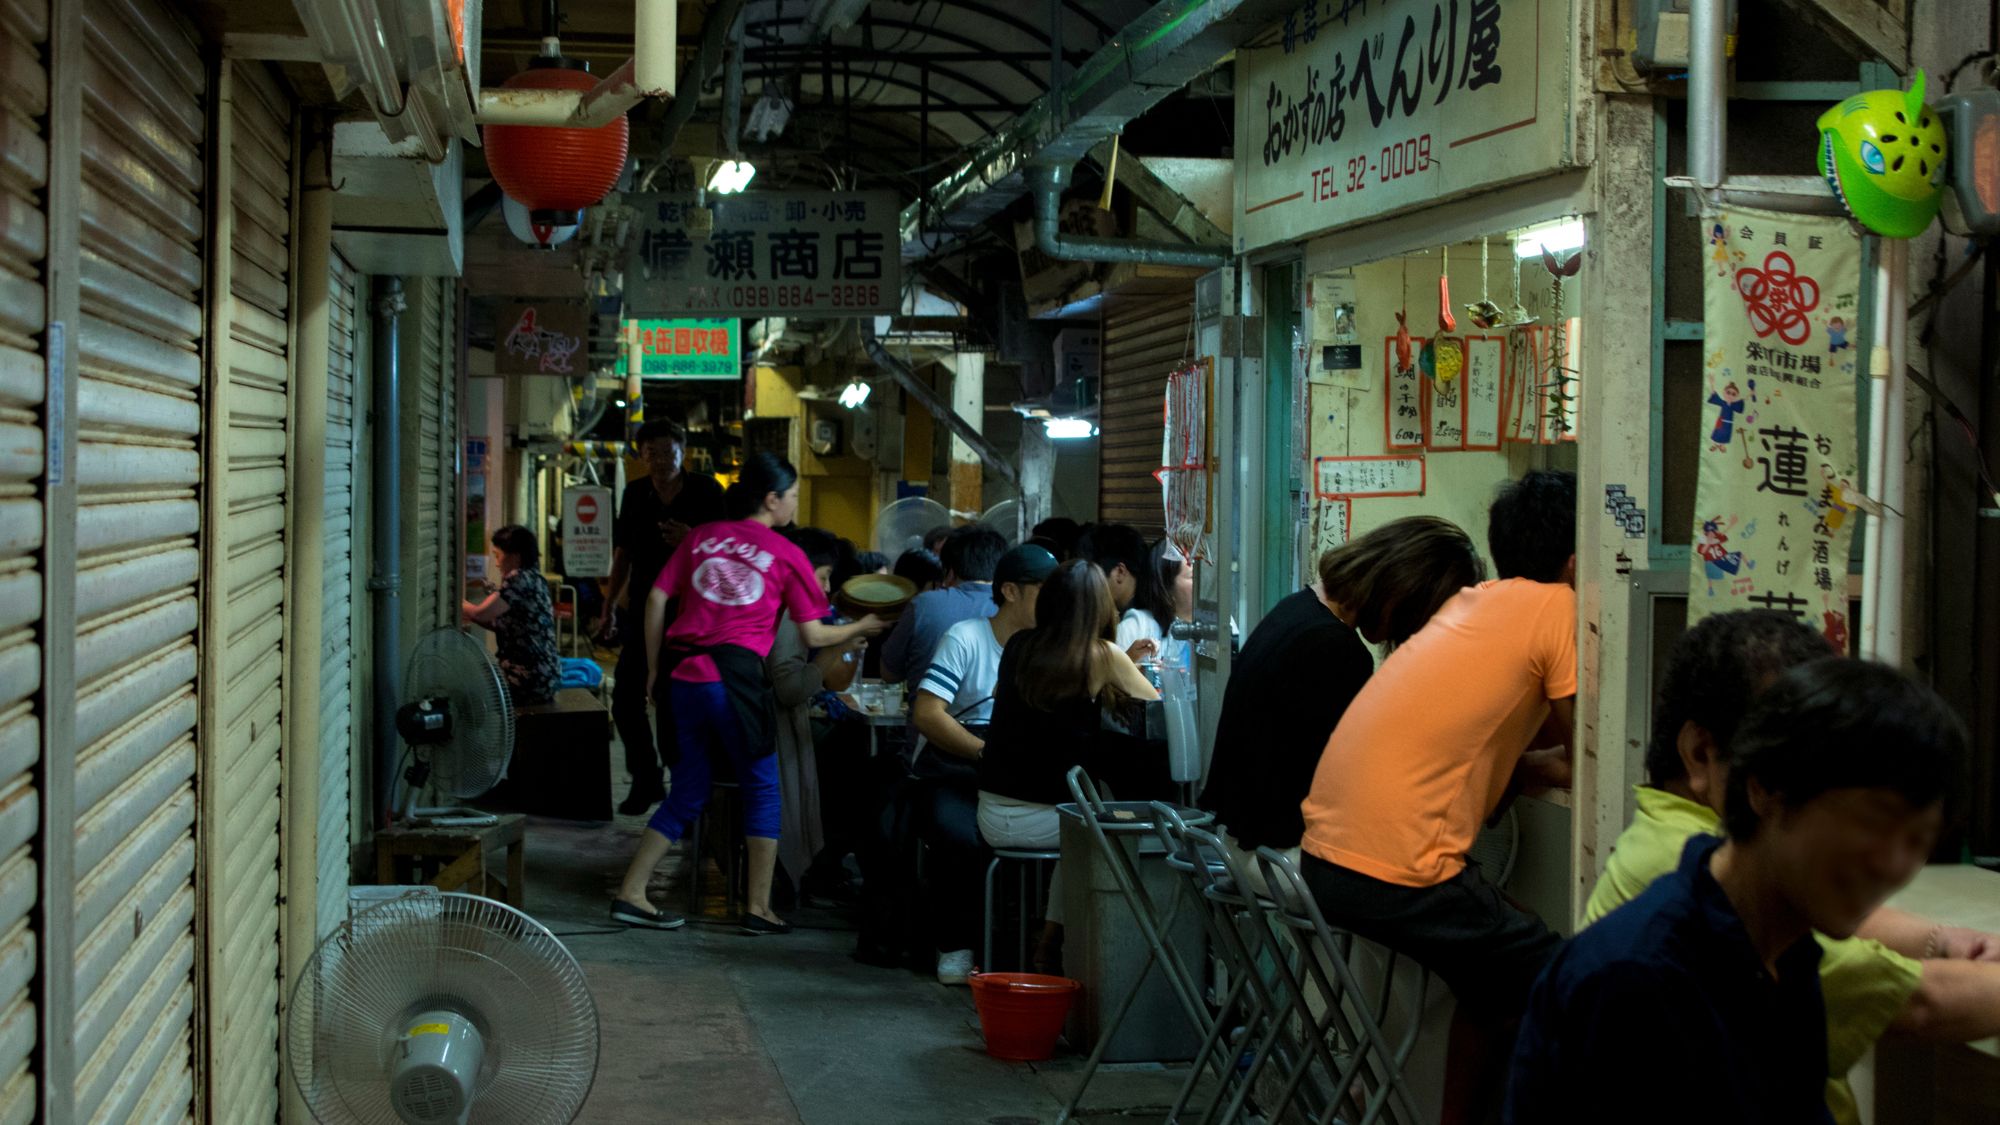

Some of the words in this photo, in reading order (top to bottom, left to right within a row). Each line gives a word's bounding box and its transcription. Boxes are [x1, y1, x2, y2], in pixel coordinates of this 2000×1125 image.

[1312, 168, 1339, 203] TEL
[1347, 133, 1432, 193] 32-0009
[1739, 225, 1824, 251] 会員証
[1757, 425, 1809, 498] 蓮
[1775, 511, 1792, 577] れんげ
